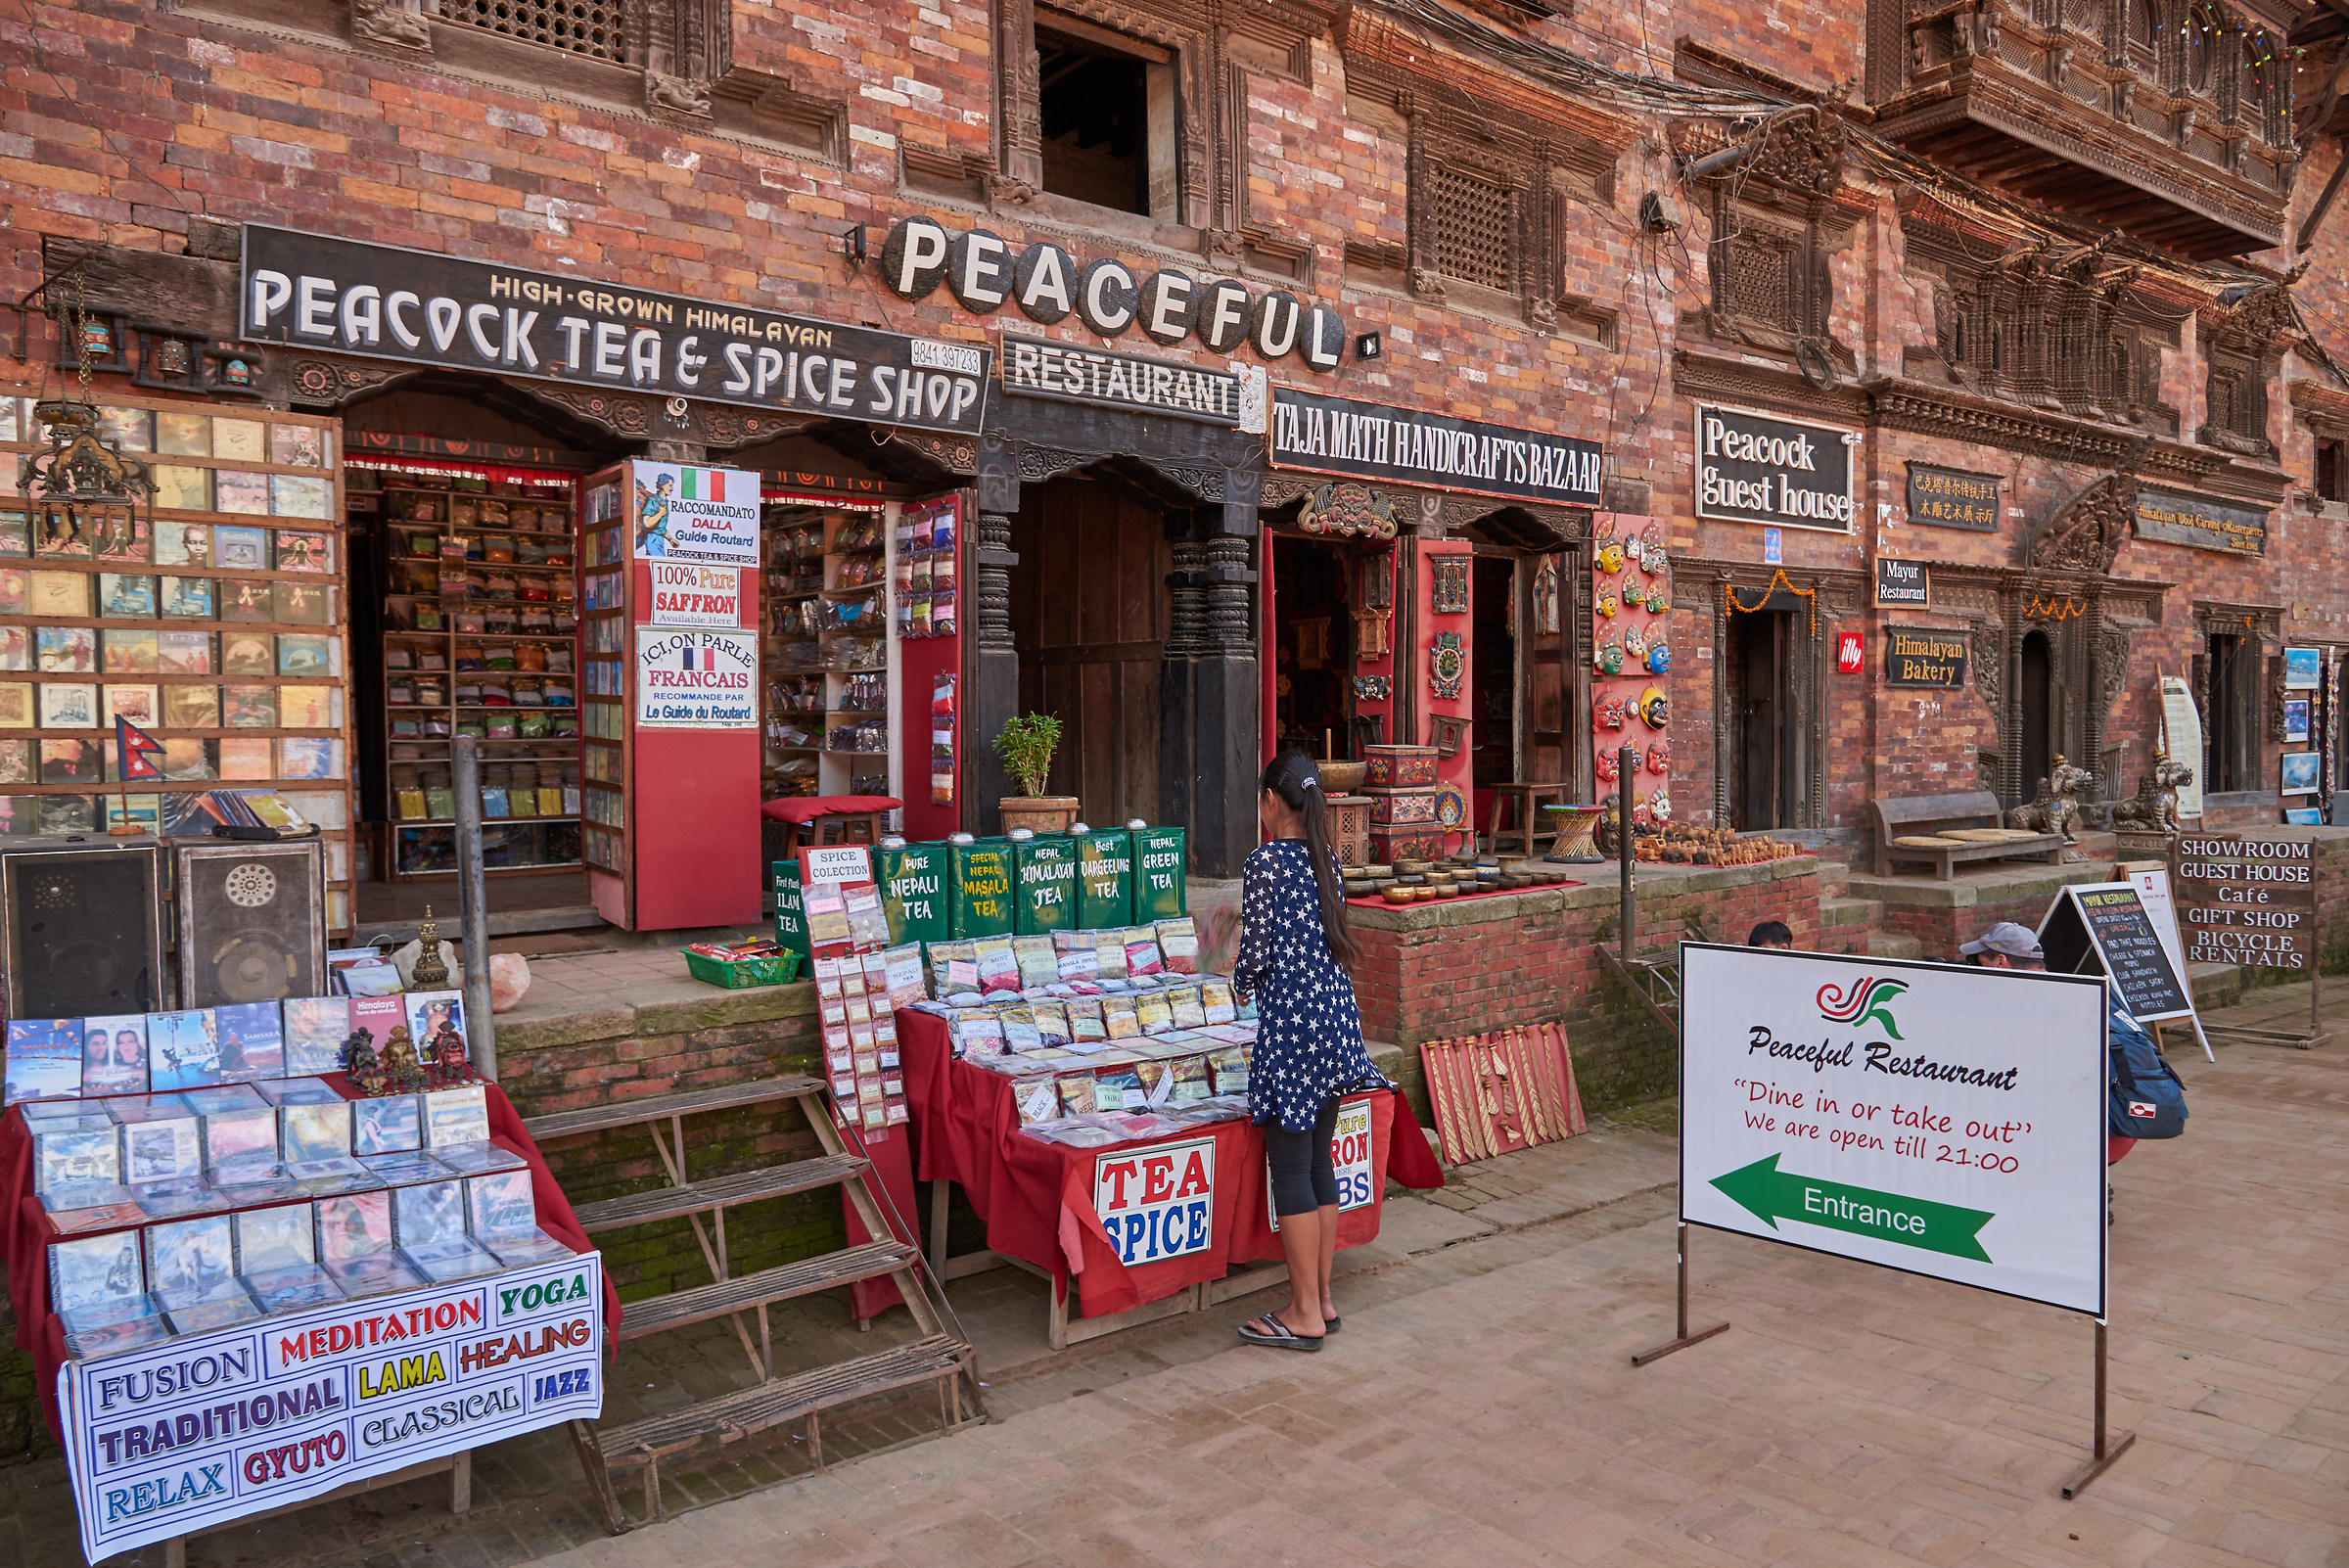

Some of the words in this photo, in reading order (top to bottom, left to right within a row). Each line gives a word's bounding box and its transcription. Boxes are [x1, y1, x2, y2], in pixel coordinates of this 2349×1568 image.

[898, 222, 1337, 366] PEACEFUL
[686, 308, 832, 347] HIMALAYAN
[250, 269, 539, 372] PEACOCK
[556, 316, 661, 388] TEA
[676, 336, 707, 388] &
[723, 343, 856, 409] SPICE
[870, 366, 977, 424] SHOP
[912, 341, 939, 365] 9841
[942, 345, 979, 373] 397233
[1014, 344, 1235, 417] RESTAURANT
[1274, 402, 1326, 456] TAJA
[1330, 411, 1390, 464] MATH
[1393, 422, 1526, 484] HANDICRAFTS
[1529, 443, 1600, 494] BAZAAR
[1704, 417, 1816, 472] Peacock
[1703, 465, 1773, 512] guest
[1777, 474, 1849, 523] house
[670, 500, 756, 520] RACCOMANDATO
[1920, 499, 1994, 525] 木雕艺术展示厅
[692, 518, 732, 530] DALLA
[2195, 514, 2220, 535] Carving
[675, 530, 708, 543] Guide
[712, 531, 754, 547] Routard
[668, 549, 699, 559] PEACOCK
[657, 566, 697, 586] 100%
[700, 568, 736, 589] Pure
[1886, 561, 1918, 582] Mayur
[656, 592, 736, 614] SAFFRON
[1879, 583, 1925, 602] Restaurant
[659, 615, 706, 624] Available
[702, 633, 755, 668] PARLE
[1841, 637, 1863, 669] illy
[1894, 635, 1962, 663] Himalayan
[649, 670, 749, 689] FRANCAIS
[1903, 661, 1955, 685] Bakery
[654, 692, 723, 701] RECOMMANDE
[646, 705, 659, 718] Le
[663, 705, 693, 719] Guide
[695, 706, 710, 719] du
[712, 706, 751, 720] Routard
[1036, 848, 1060, 860] NEPAL
[1150, 837, 1175, 851] NEPAL
[2182, 840, 2310, 860] SHOWROOM
[820, 852, 856, 862] SPICE
[905, 855, 928, 871] PURE
[970, 852, 999, 864] SPECIAL
[1143, 852, 1179, 869] GREEN
[813, 865, 867, 878] COLECTION
[970, 864, 998, 877] NEPAL
[1020, 860, 1075, 885] HIMALAYAN
[2180, 862, 2240, 880] GUEST
[2246, 865, 2310, 882] HOUSE
[891, 875, 939, 898] NEPALI
[964, 878, 1009, 897] MASALA
[1095, 881, 1120, 899] TEA
[1150, 873, 1173, 890] TEA
[777, 893, 801, 910] ILAM
[1035, 886, 1063, 909] TEA
[2219, 886, 2268, 903] Café
[902, 899, 933, 920] TEA
[973, 900, 998, 918] TEA
[2188, 907, 2234, 925] GIFT
[2243, 911, 2300, 929] SHOP
[779, 915, 799, 933] TEA
[2118, 938, 2133, 946] THAI
[2133, 937, 2156, 946] NOODLES
[2196, 931, 2294, 952] BICYCLE
[2133, 948, 2156, 958] SPINACH
[2188, 945, 2303, 969] RENTALS
[893, 967, 918, 979] NEPALI
[1058, 959, 1080, 969] MASALA
[2117, 971, 2131, 980] CLUB
[2132, 967, 2158, 978] SANDWICH
[2123, 981, 2146, 992] CHICKEN
[2126, 992, 2149, 1002] CHICKEN
[357, 1000, 395, 1011] Himalaya
[243, 1031, 281, 1040] SAMSARA
[1748, 1025, 1854, 1073] Peaceful
[1864, 1041, 2018, 1090] Restaurant
[1033, 1099, 1047, 1119] BLACK
[1079, 1101, 1093, 1114] RED
[1816, 1089, 1840, 1115] in
[1851, 1102, 1882, 1122] or
[1892, 1105, 1953, 1133] take
[1744, 1110, 1776, 1132] We
[1784, 1120, 1819, 1139] are
[1829, 1129, 1884, 1157] open
[1894, 1135, 1926, 1160] till
[1936, 1143, 2019, 1174] 21:00
[1101, 1151, 1210, 1211] TEA
[1804, 1186, 1926, 1235] Entrance
[1102, 1200, 1207, 1264] SPICE
[499, 1273, 588, 1316] YOGA
[280, 1296, 482, 1367] MEDITATION
[460, 1318, 590, 1374] HEALING
[99, 1347, 249, 1409] FUSION
[358, 1352, 446, 1400] LAMA
[533, 1368, 590, 1405] JAZZ
[99, 1377, 342, 1465] TRADITIONAL
[362, 1389, 520, 1449] CLASSICAL
[244, 1429, 345, 1486] GYUTO
[105, 1462, 225, 1523] RELAX
